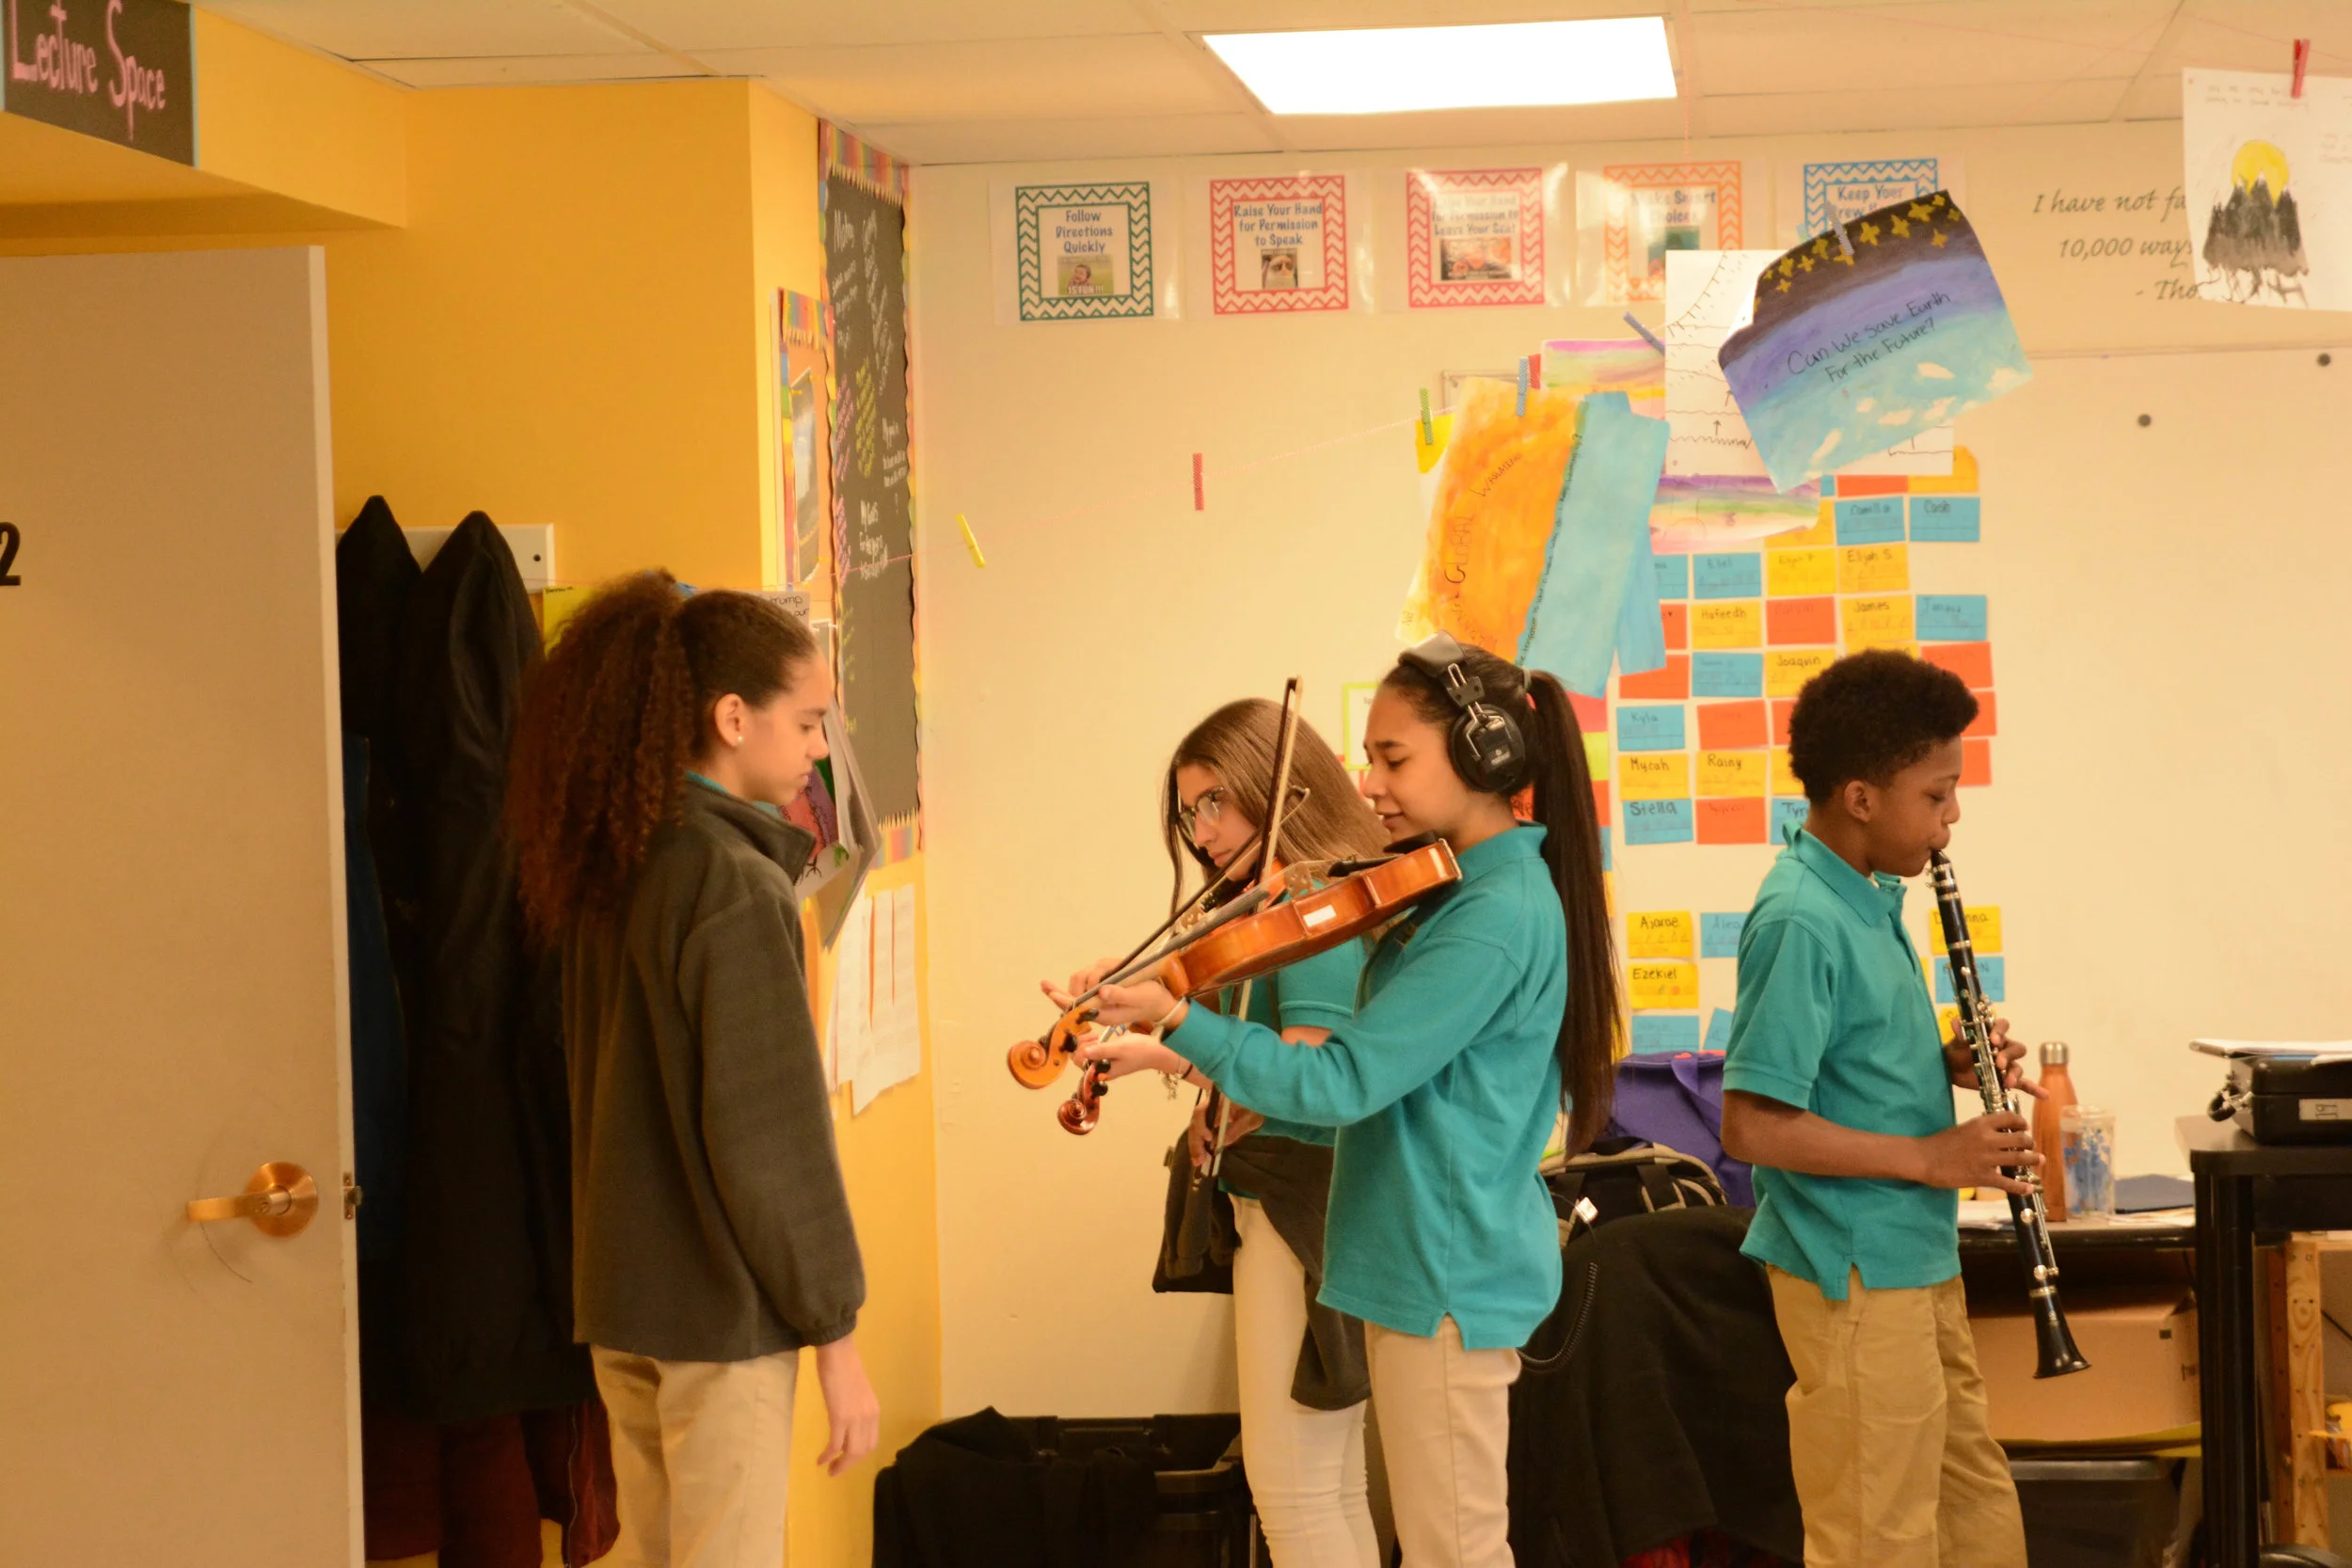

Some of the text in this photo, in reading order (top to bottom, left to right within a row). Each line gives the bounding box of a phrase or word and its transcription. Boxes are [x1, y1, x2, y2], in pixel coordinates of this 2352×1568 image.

[10, 0, 166, 141] Lecture Space
[1837, 185, 1904, 201] Keep Your
[2033, 194, 2044, 214] I
[2050, 189, 2106, 214] have
[2116, 189, 2157, 211] not
[1065, 210, 1102, 222] Follow
[1233, 202, 1323, 217] Raise Your Hand
[1056, 226, 1114, 239] Directions
[1239, 218, 1318, 232] for Permission
[1467, 223, 1489, 234] Your
[1063, 240, 1105, 255] Quickly
[1255, 233, 1303, 247] to Speak
[2058, 237, 2134, 262] 10,000
[1787, 291, 1951, 375] Can We Save Earth
[1824, 316, 1935, 383] For the Future?
[0, 521, 21, 587] 2
[1775, 654, 1821, 669] Joaquin
[1629, 801, 1678, 816] Stella
[1632, 968, 1677, 980] Ezekiel
